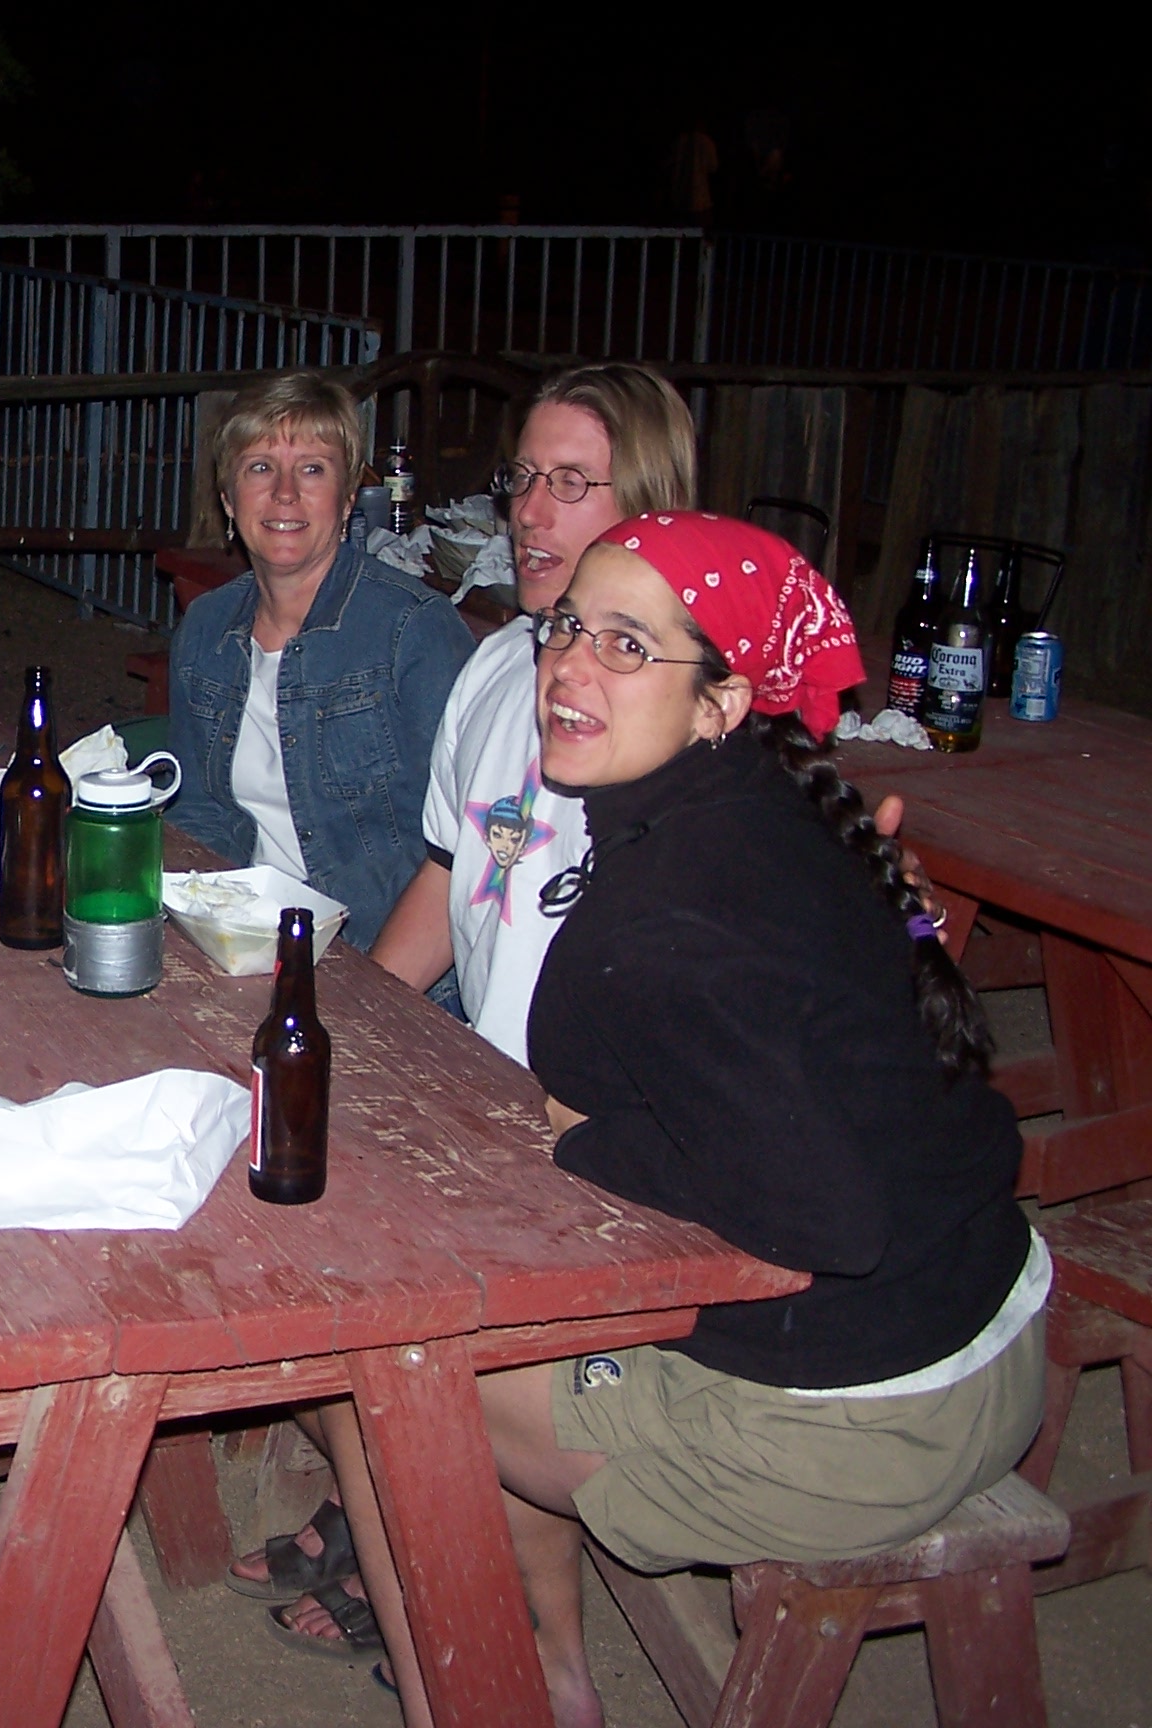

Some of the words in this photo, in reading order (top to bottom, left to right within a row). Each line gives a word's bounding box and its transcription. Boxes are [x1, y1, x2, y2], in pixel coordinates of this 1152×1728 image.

[894, 653, 924, 665] BUD
[931, 647, 977, 668] Corona
[938, 664, 966, 676] Extra
